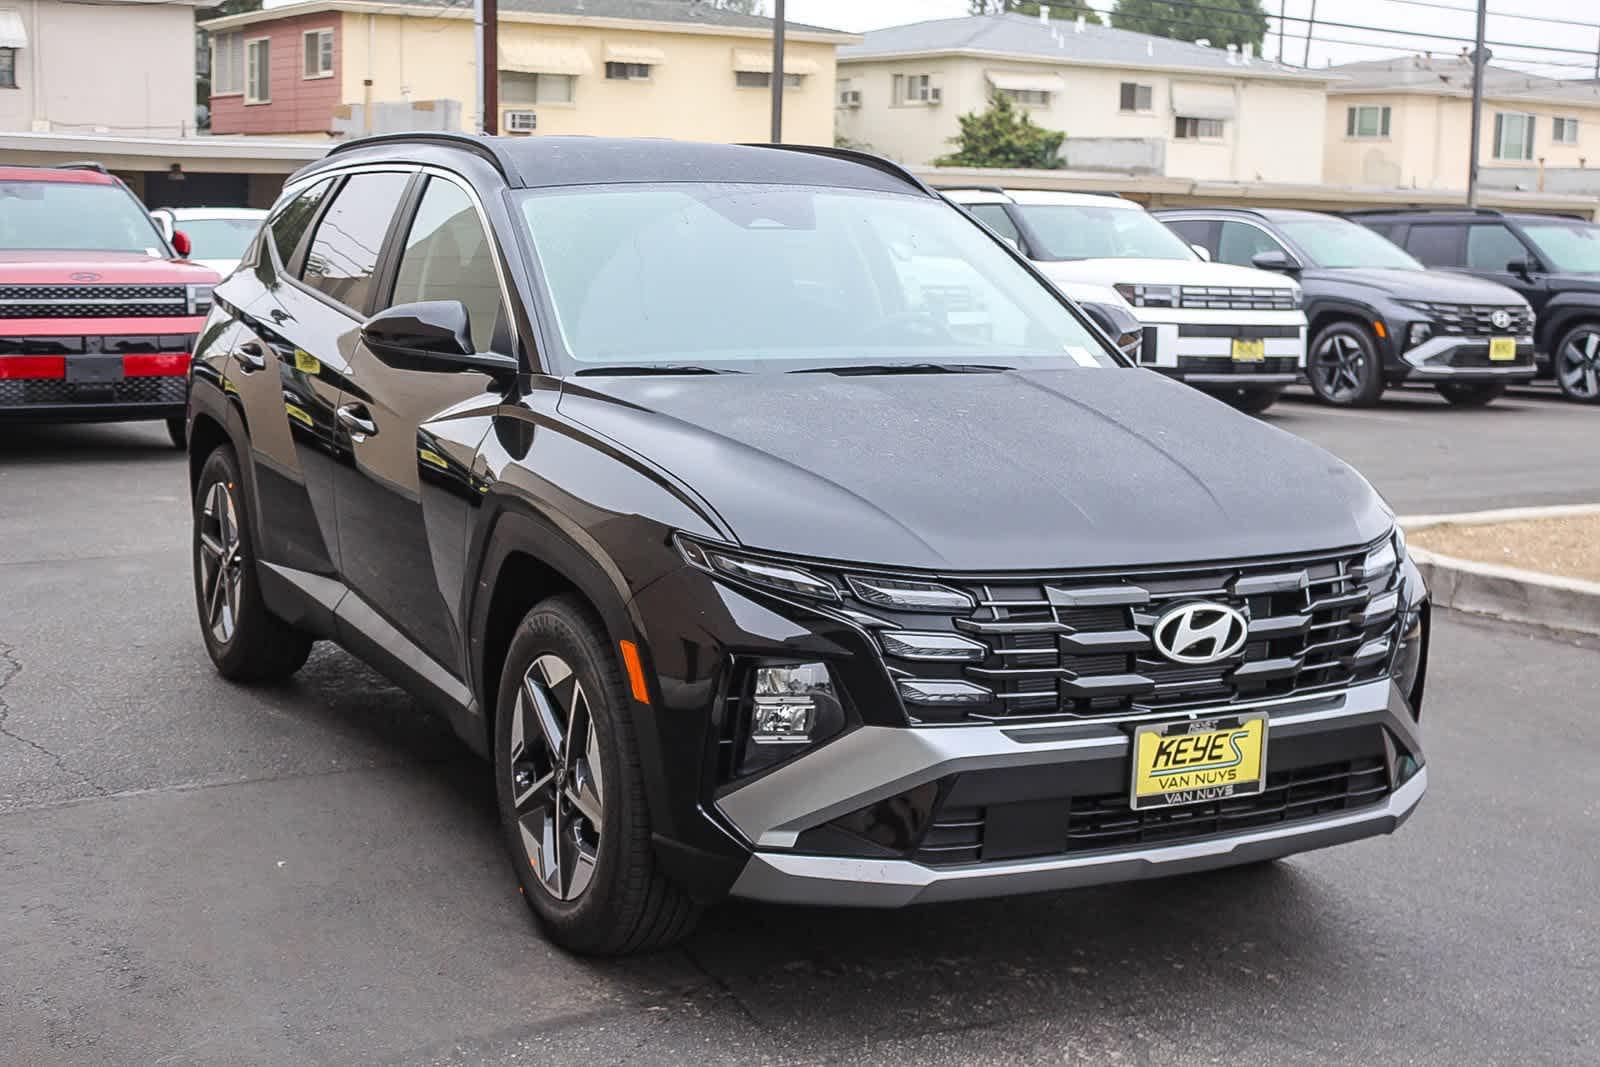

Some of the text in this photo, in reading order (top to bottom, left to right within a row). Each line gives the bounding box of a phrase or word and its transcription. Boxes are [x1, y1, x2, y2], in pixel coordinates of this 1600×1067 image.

[1151, 730, 1249, 769] KEYES
[1158, 768, 1237, 790] VAN NUYS
[1165, 785, 1234, 804] VAN NUYS
